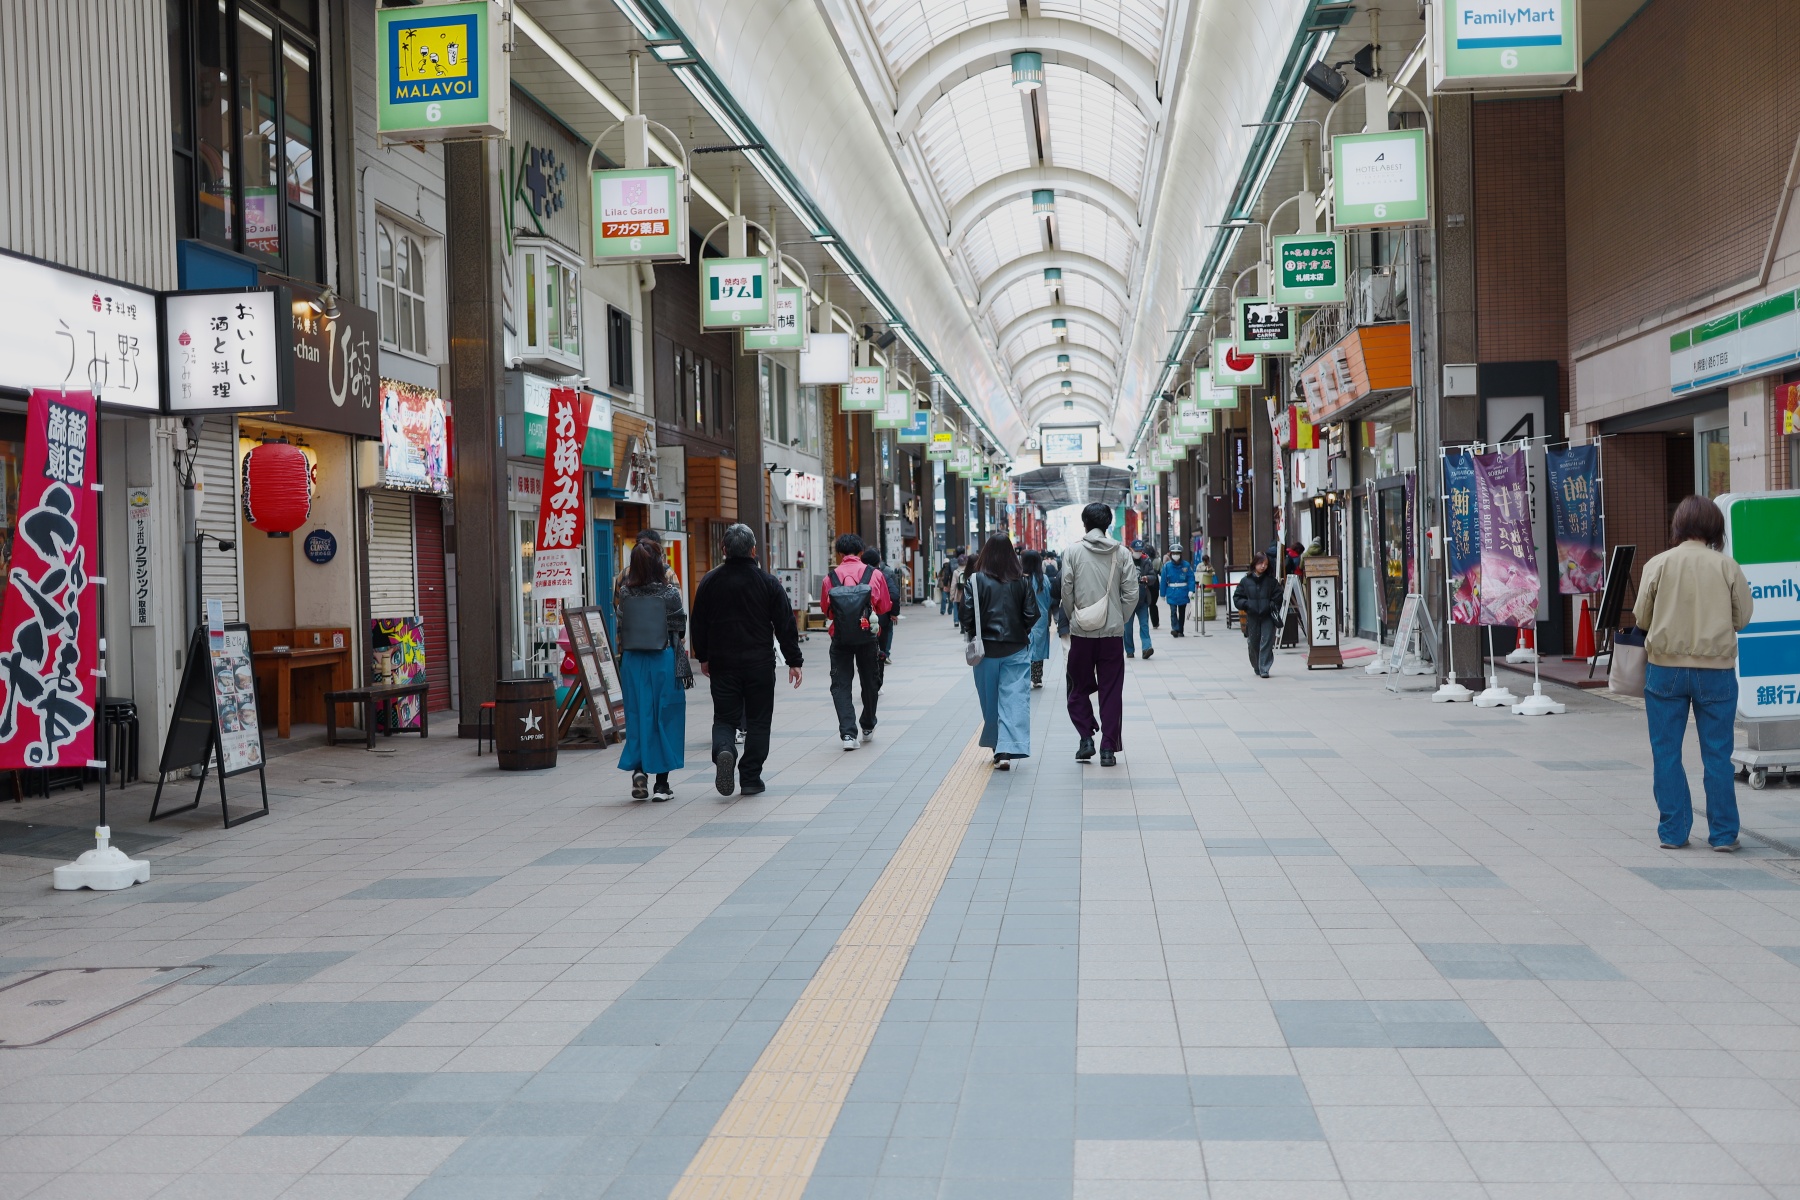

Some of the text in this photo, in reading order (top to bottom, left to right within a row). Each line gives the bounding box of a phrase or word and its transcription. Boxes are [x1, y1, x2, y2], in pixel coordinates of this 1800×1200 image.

[1464, 8, 1555, 25] FamilyMart
[1501, 49, 1517, 69] 6
[396, 80, 471, 98] MALAVOI
[426, 103, 441, 122] 6
[605, 207, 665, 217] Lilac Garden
[1374, 204, 1386, 218] 6
[607, 221, 665, 236] アガタ薬局
[629, 237, 641, 252] 6
[724, 277, 748, 286] 焼肉亭
[721, 285, 751, 298] サム
[1304, 289, 1314, 300] 6
[731, 310, 741, 322] 6
[234, 302, 256, 386] おいしい
[769, 335, 778, 345] 6
[1262, 340, 1270, 350] 6
[55, 318, 140, 393] うみ野
[210, 316, 231, 398] 酒と料理
[1234, 375, 1242, 383] 6
[1751, 579, 1800, 602] amily
[1757, 684, 1800, 706] 銀行
